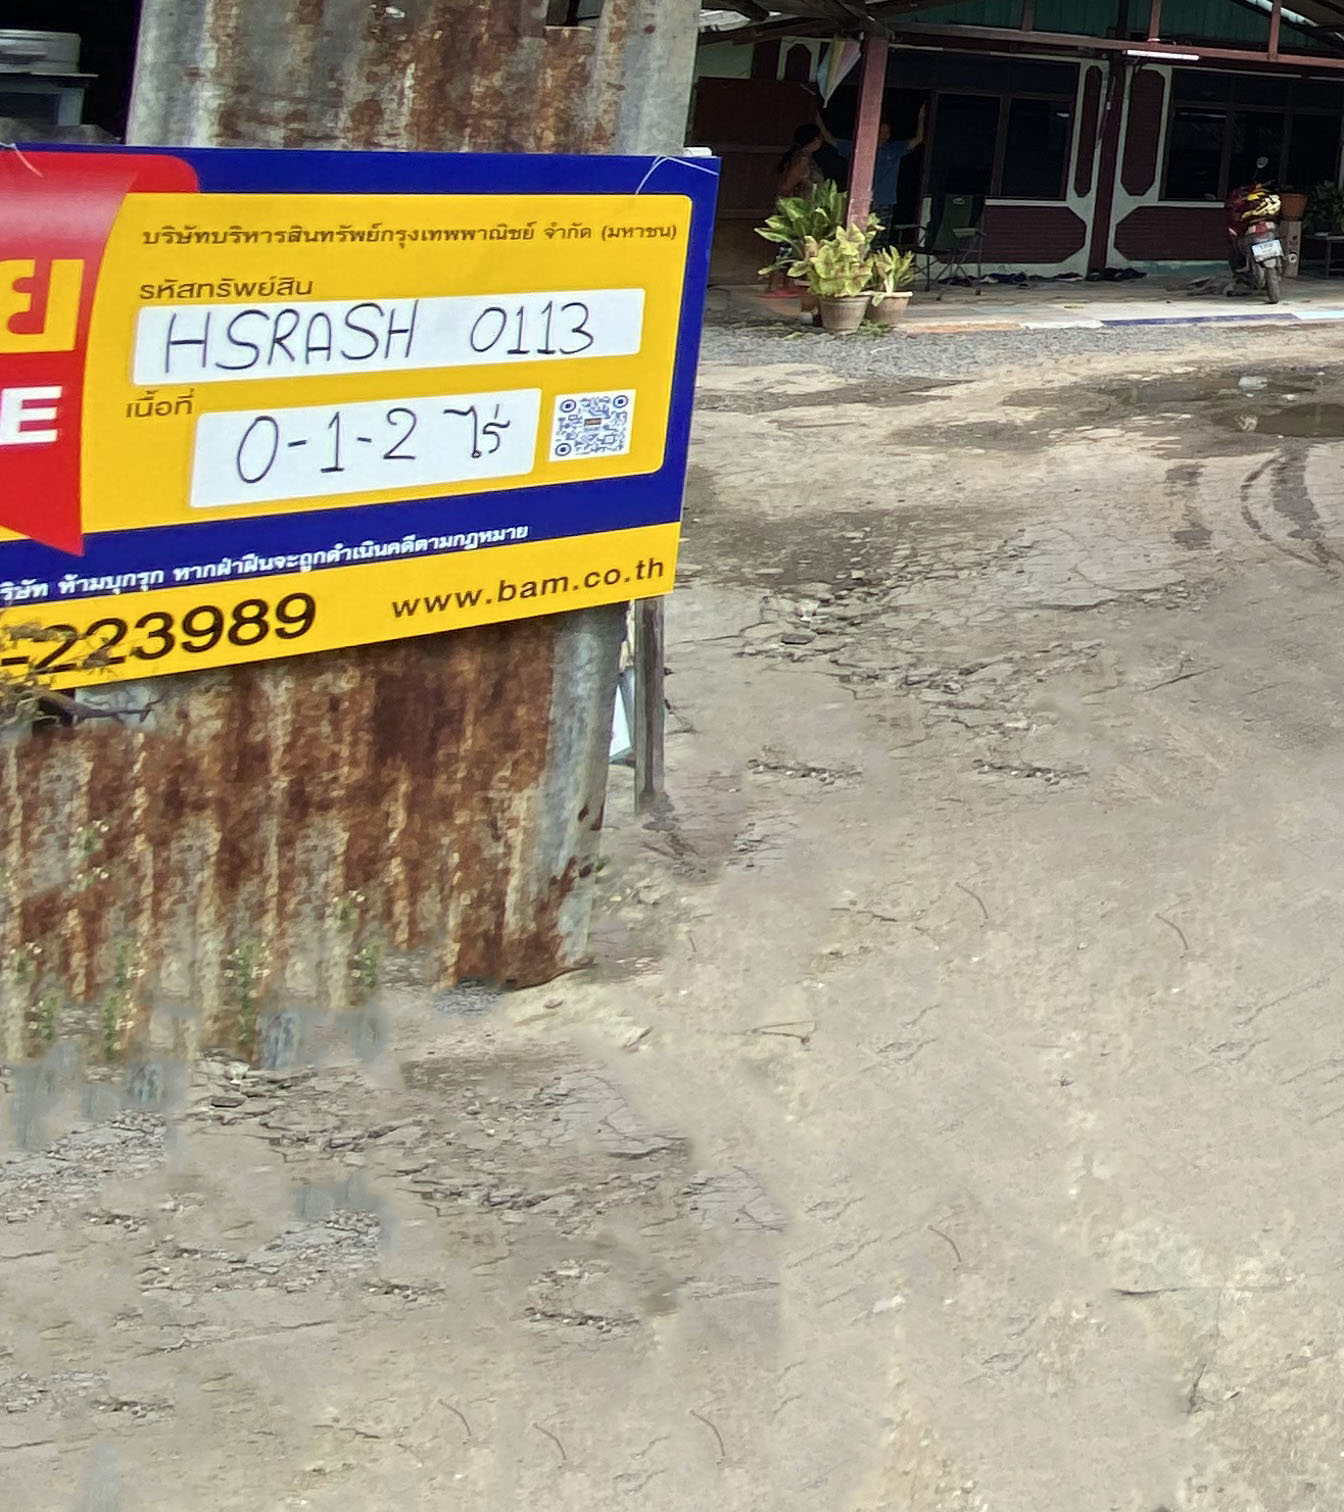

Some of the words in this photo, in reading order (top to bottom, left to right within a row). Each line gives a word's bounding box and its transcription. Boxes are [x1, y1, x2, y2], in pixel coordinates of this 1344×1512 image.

[143, 222, 537, 249] บริษัทบริหารสินทรัพย์กรุงเทพพาณิชย์
[544, 223, 592, 240] จำกัด
[601, 225, 677, 242] (มหาชน)
[139, 276, 314, 300] รหัสทรัพย์สิน
[165, 299, 419, 374] HSRASH
[470, 301, 594, 356] 0113
[0, 386, 62, 445] E
[125, 388, 194, 418] เนื้อที่
[236, 407, 417, 484] 0-1-2
[443, 403, 511, 459] ไร่
[57, 569, 164, 595] ห้ามบุกรุก
[392, 557, 665, 619] www.bam.co.th
